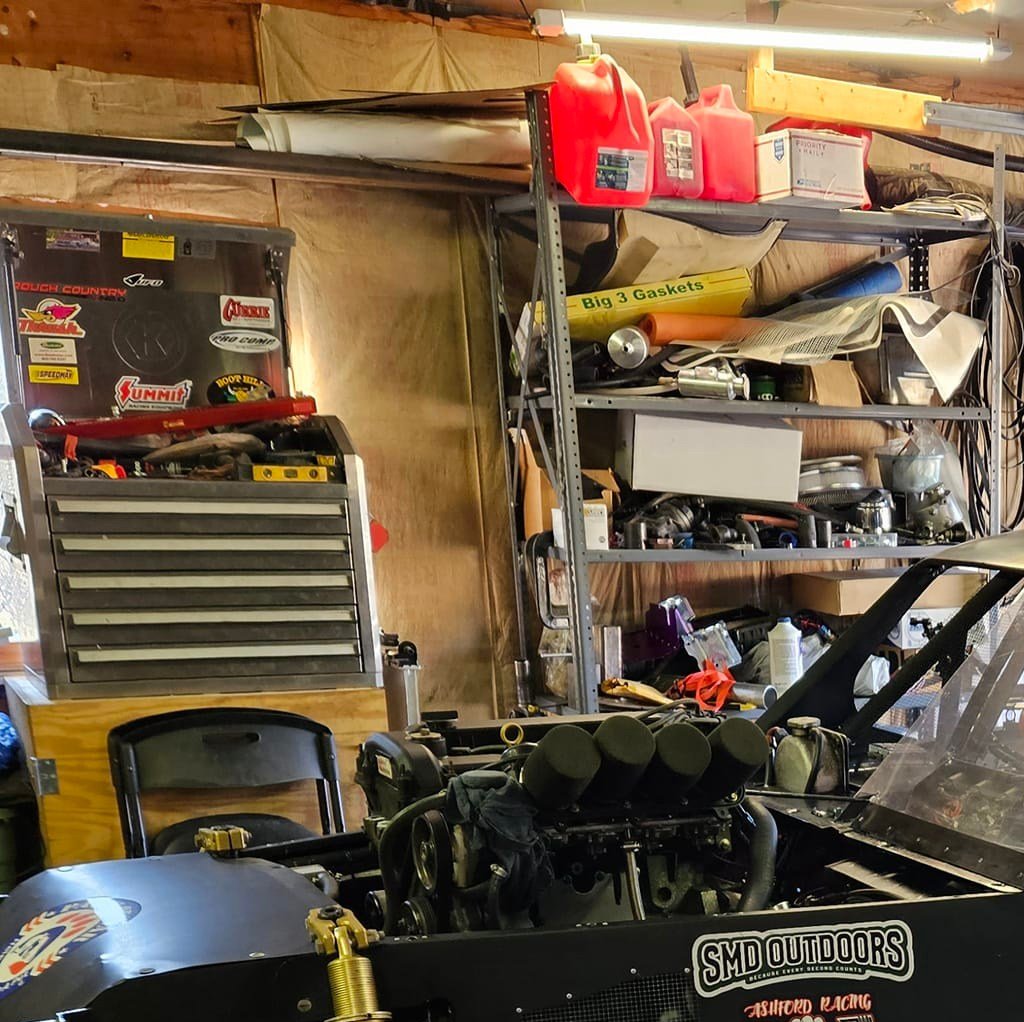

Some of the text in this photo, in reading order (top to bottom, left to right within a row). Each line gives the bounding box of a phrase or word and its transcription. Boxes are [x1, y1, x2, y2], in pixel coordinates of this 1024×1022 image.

[15, 281, 127, 297] ROUGH COUNTRY
[581, 280, 705, 309] Big 3 Gaskets
[213, 334, 276, 345] PRO COMP
[119, 379, 187, 406] SUMMIT
[701, 929, 907, 986] SMD OUTDOORS
[749, 970, 780, 981] BECAUSE
[835, 965, 862, 973] COUNTS
[744, 993, 873, 1019] ASHFORD RACING
